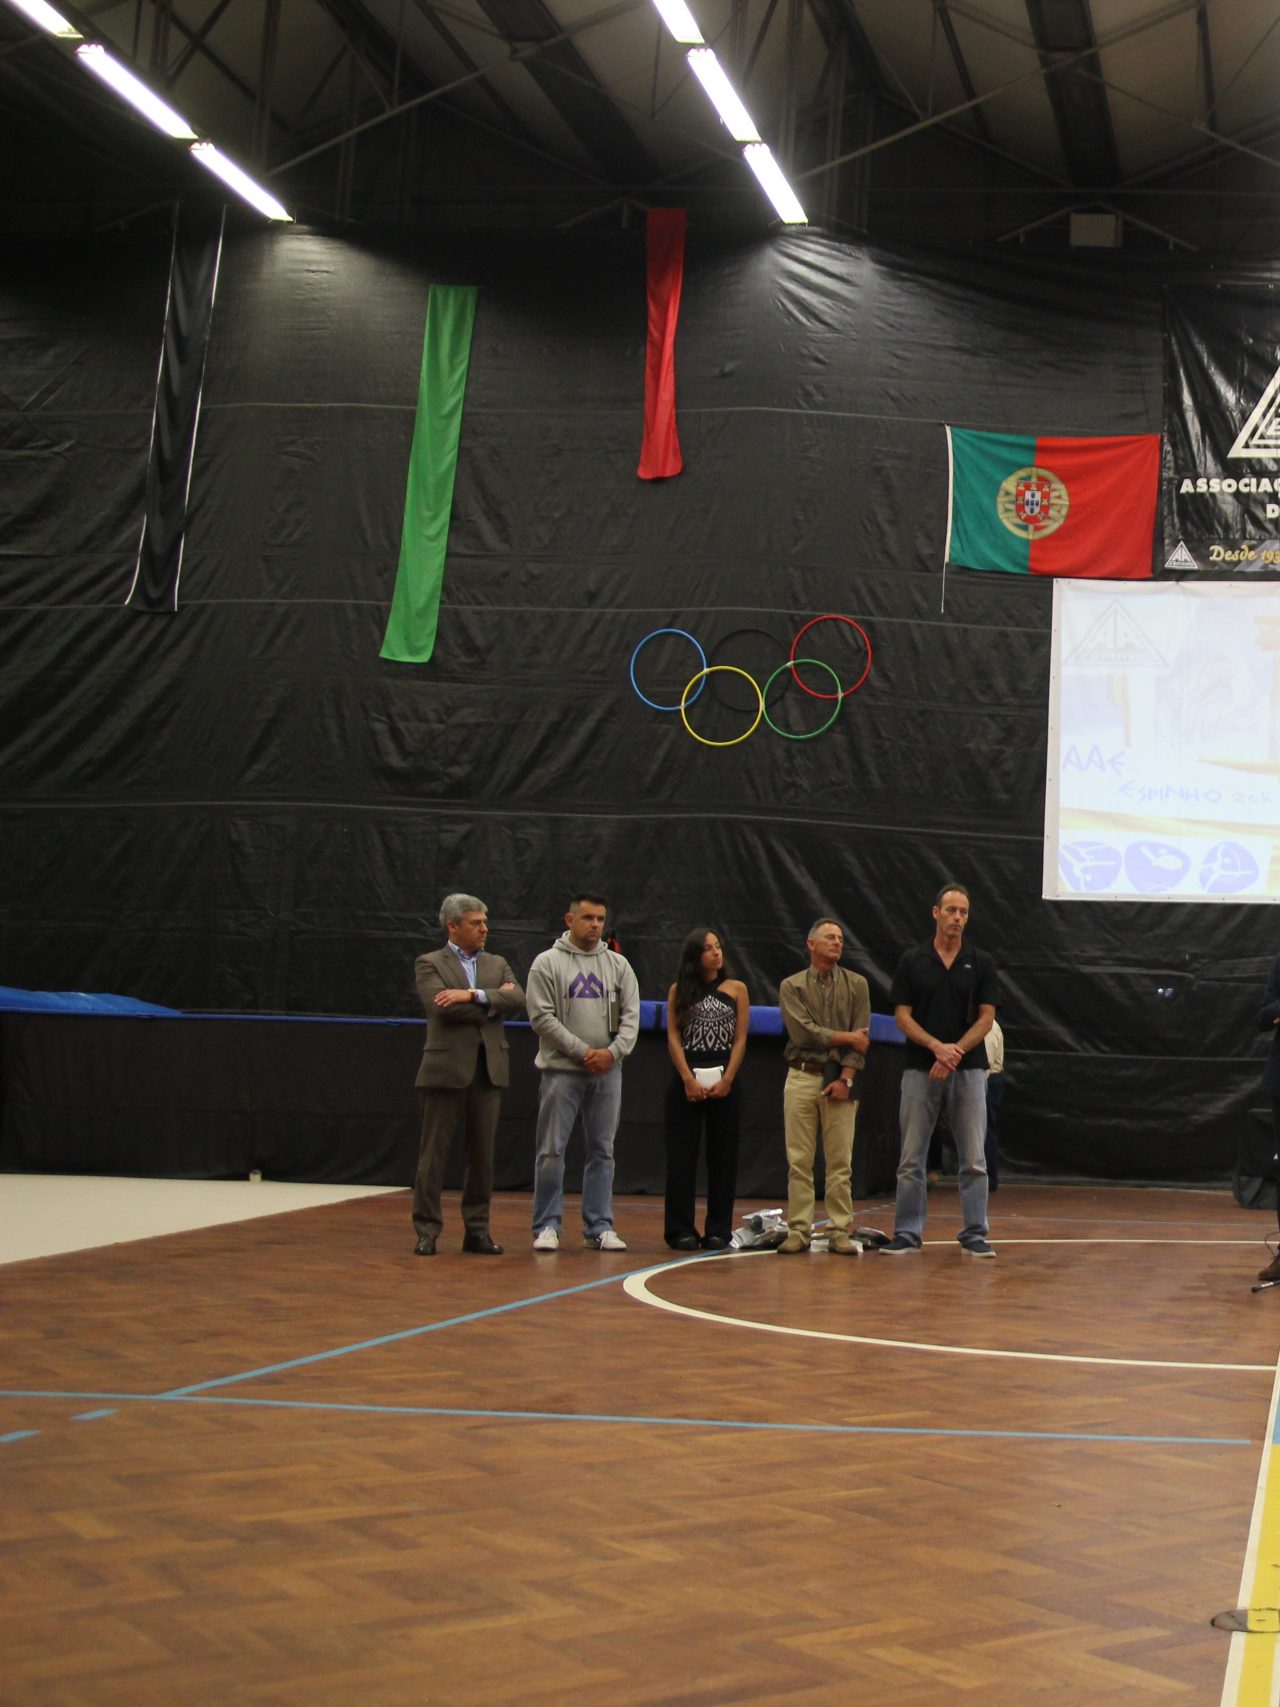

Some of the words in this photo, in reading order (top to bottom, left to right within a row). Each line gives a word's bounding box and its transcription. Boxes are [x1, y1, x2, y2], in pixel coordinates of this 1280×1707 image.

[1209, 545, 1257, 561] Desde
[1062, 743, 1126, 776] AAE
[1118, 779, 1223, 804] ESPINHO
